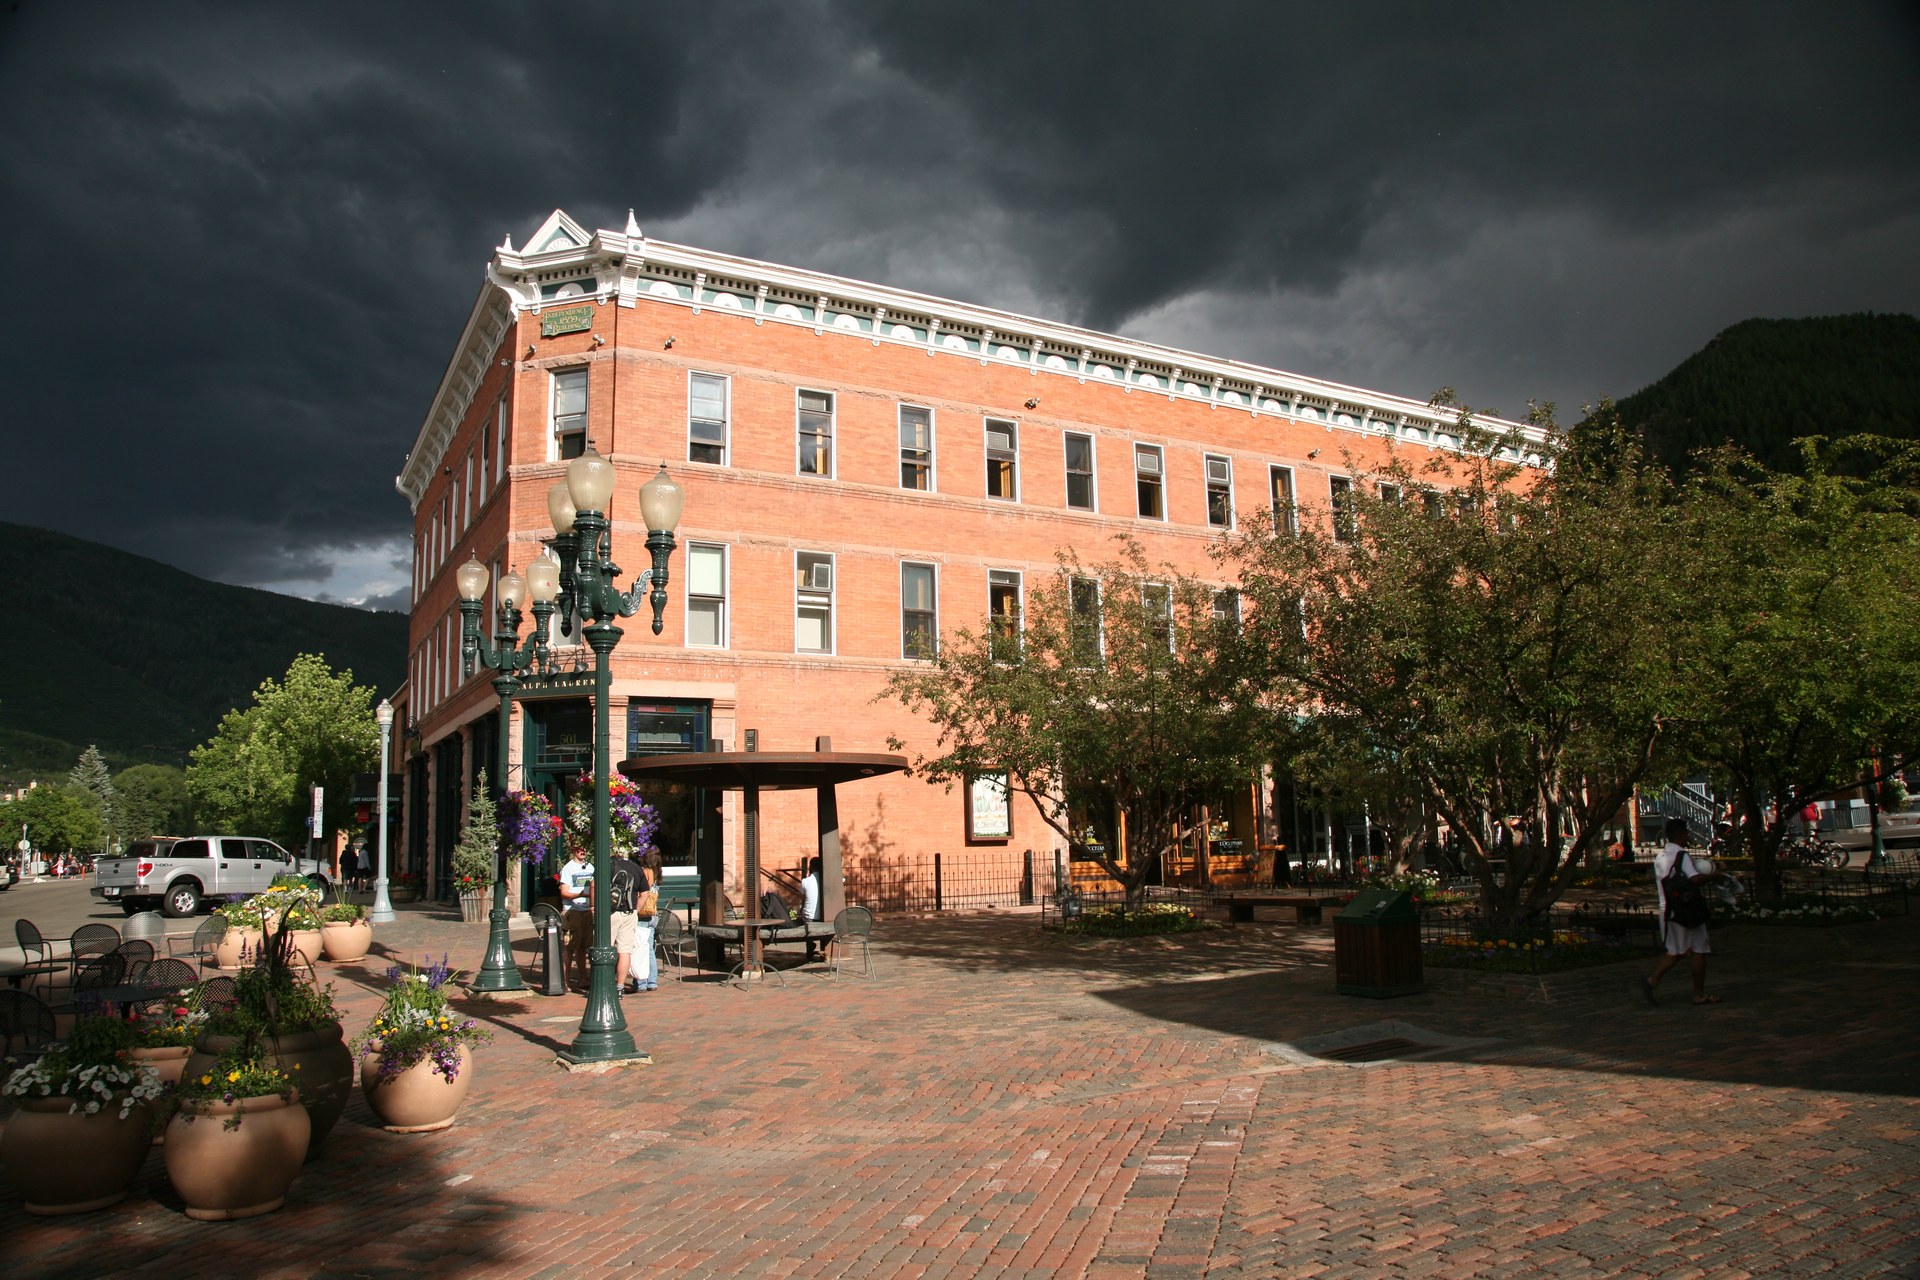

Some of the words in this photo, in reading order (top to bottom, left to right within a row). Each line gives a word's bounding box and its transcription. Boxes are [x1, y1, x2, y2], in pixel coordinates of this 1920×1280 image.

[544, 308, 587, 323] INDEPENDENCE
[552, 322, 582, 335] BUILDING
[517, 682, 548, 690] ALPH
[554, 678, 596, 688] LAUREN
[560, 733, 577, 745] 501
